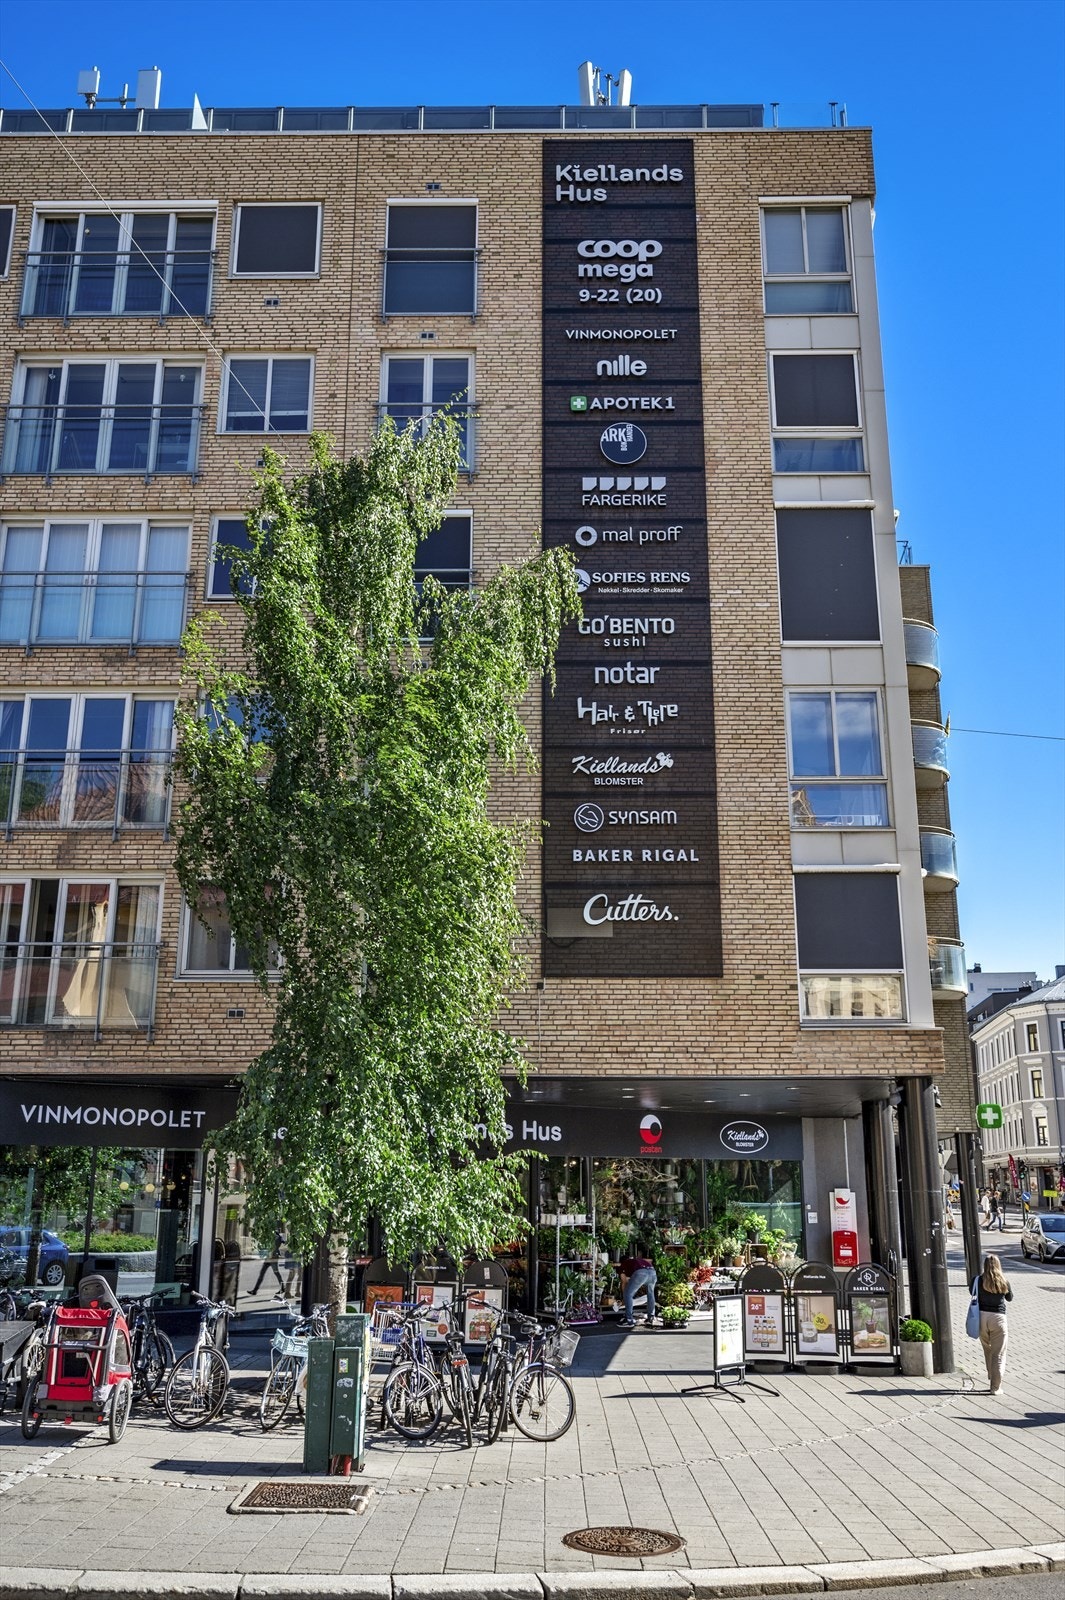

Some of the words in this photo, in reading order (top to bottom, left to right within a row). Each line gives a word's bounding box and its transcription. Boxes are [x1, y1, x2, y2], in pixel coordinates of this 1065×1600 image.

[555, 164, 684, 182] Kiellands
[555, 184, 608, 202] Hus
[577, 239, 663, 262] coop
[578, 263, 654, 283] mega
[578, 288, 620, 302] 9-22
[626, 287, 663, 304] (20)
[565, 329, 678, 339] VINMONOPOLET
[596, 354, 648, 376] nille
[601, 428, 627, 442] ARK
[582, 494, 667, 506] FARGERIKE
[602, 526, 634, 542] mal
[639, 525, 684, 546] proff
[591, 571, 646, 584] SOFIES
[650, 571, 691, 583] RENS
[604, 635, 646, 647] sushi
[594, 661, 661, 685] notar
[577, 697, 619, 726] Hair
[624, 705, 635, 723] &
[637, 700, 679, 727] There
[571, 755, 663, 776] Kiellands
[594, 777, 644, 786] BLOMSTER
[608, 810, 678, 825] SYNSAM
[572, 849, 634, 862] BAKER
[641, 849, 700, 862] RIGAL
[583, 893, 679, 926] Cutters.
[20, 1104, 206, 1128] VINMONOPOLET
[522, 1119, 562, 1142] Hus
[727, 1130, 762, 1141] Kiellands
[640, 1145, 662, 1154] posten
